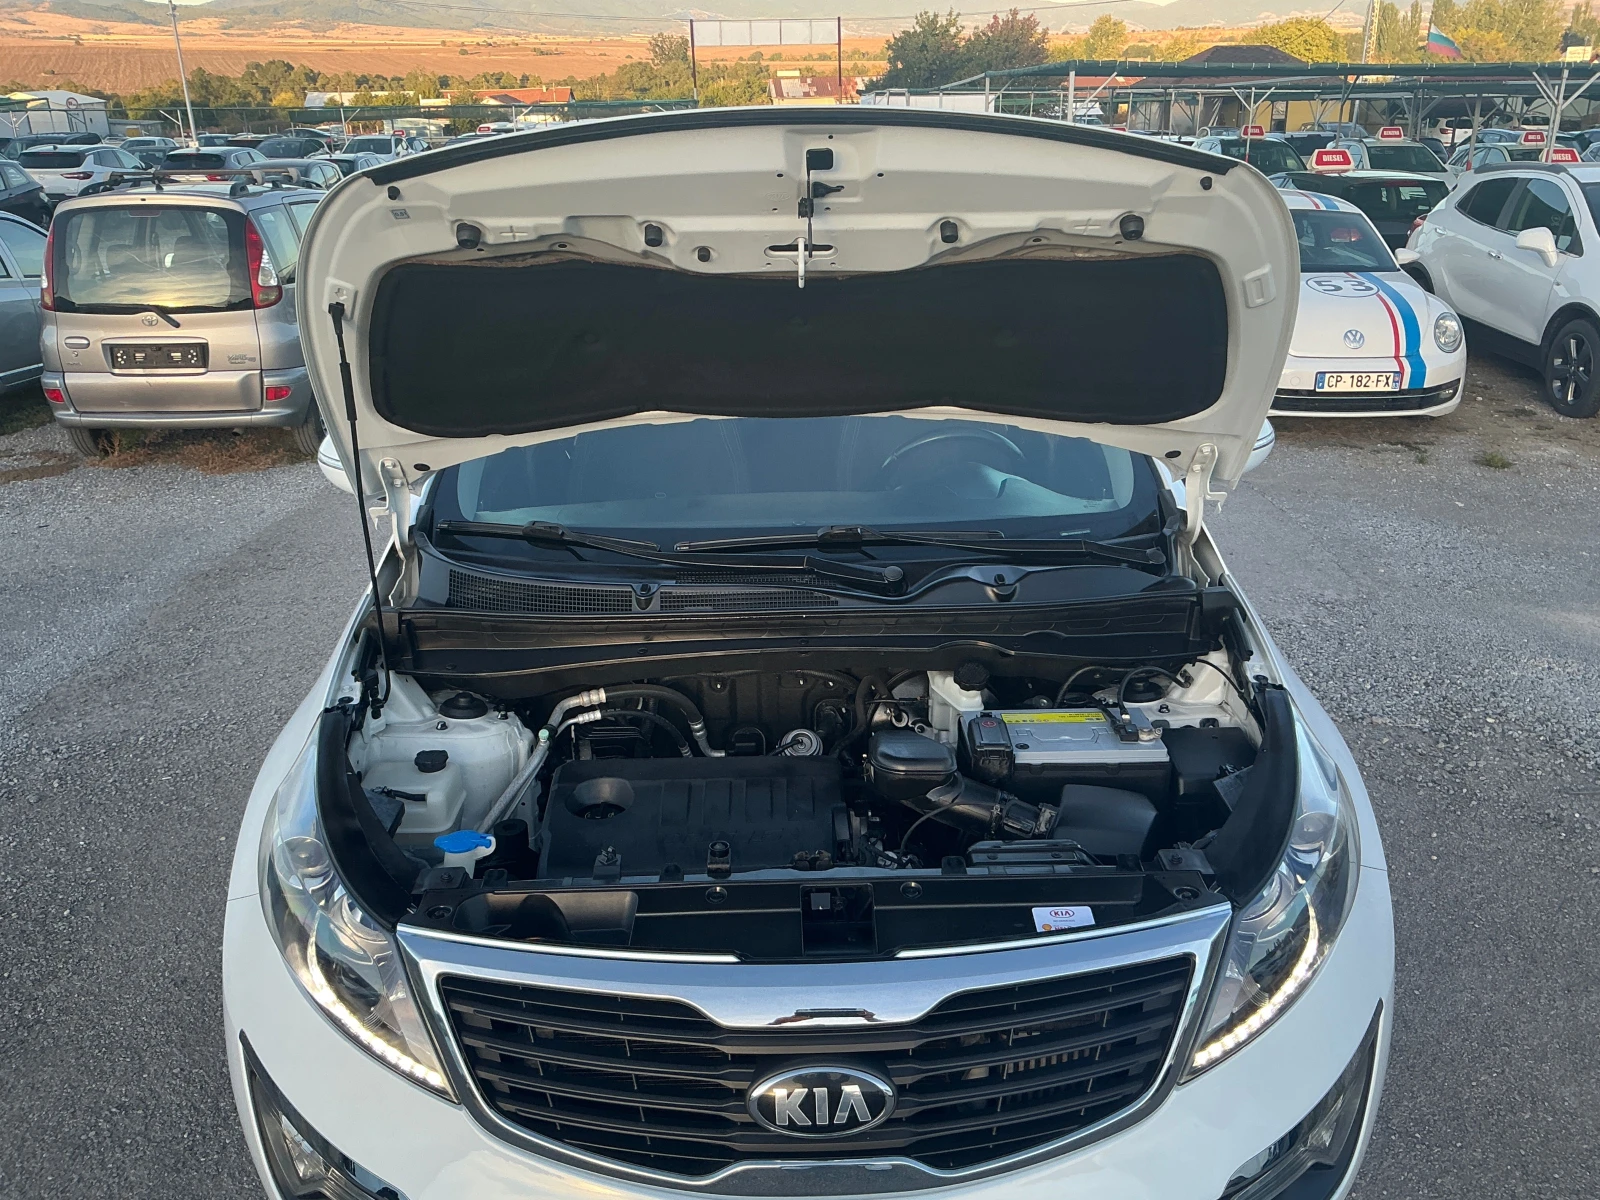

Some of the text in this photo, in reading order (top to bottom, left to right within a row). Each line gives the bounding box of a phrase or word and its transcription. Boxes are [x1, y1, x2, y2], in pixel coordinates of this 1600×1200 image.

[1322, 154, 1344, 162] DIESEL
[1553, 153, 1572, 161] DIESEL
[1313, 280, 1374, 292] 53
[772, 1084, 872, 1126] KIA
